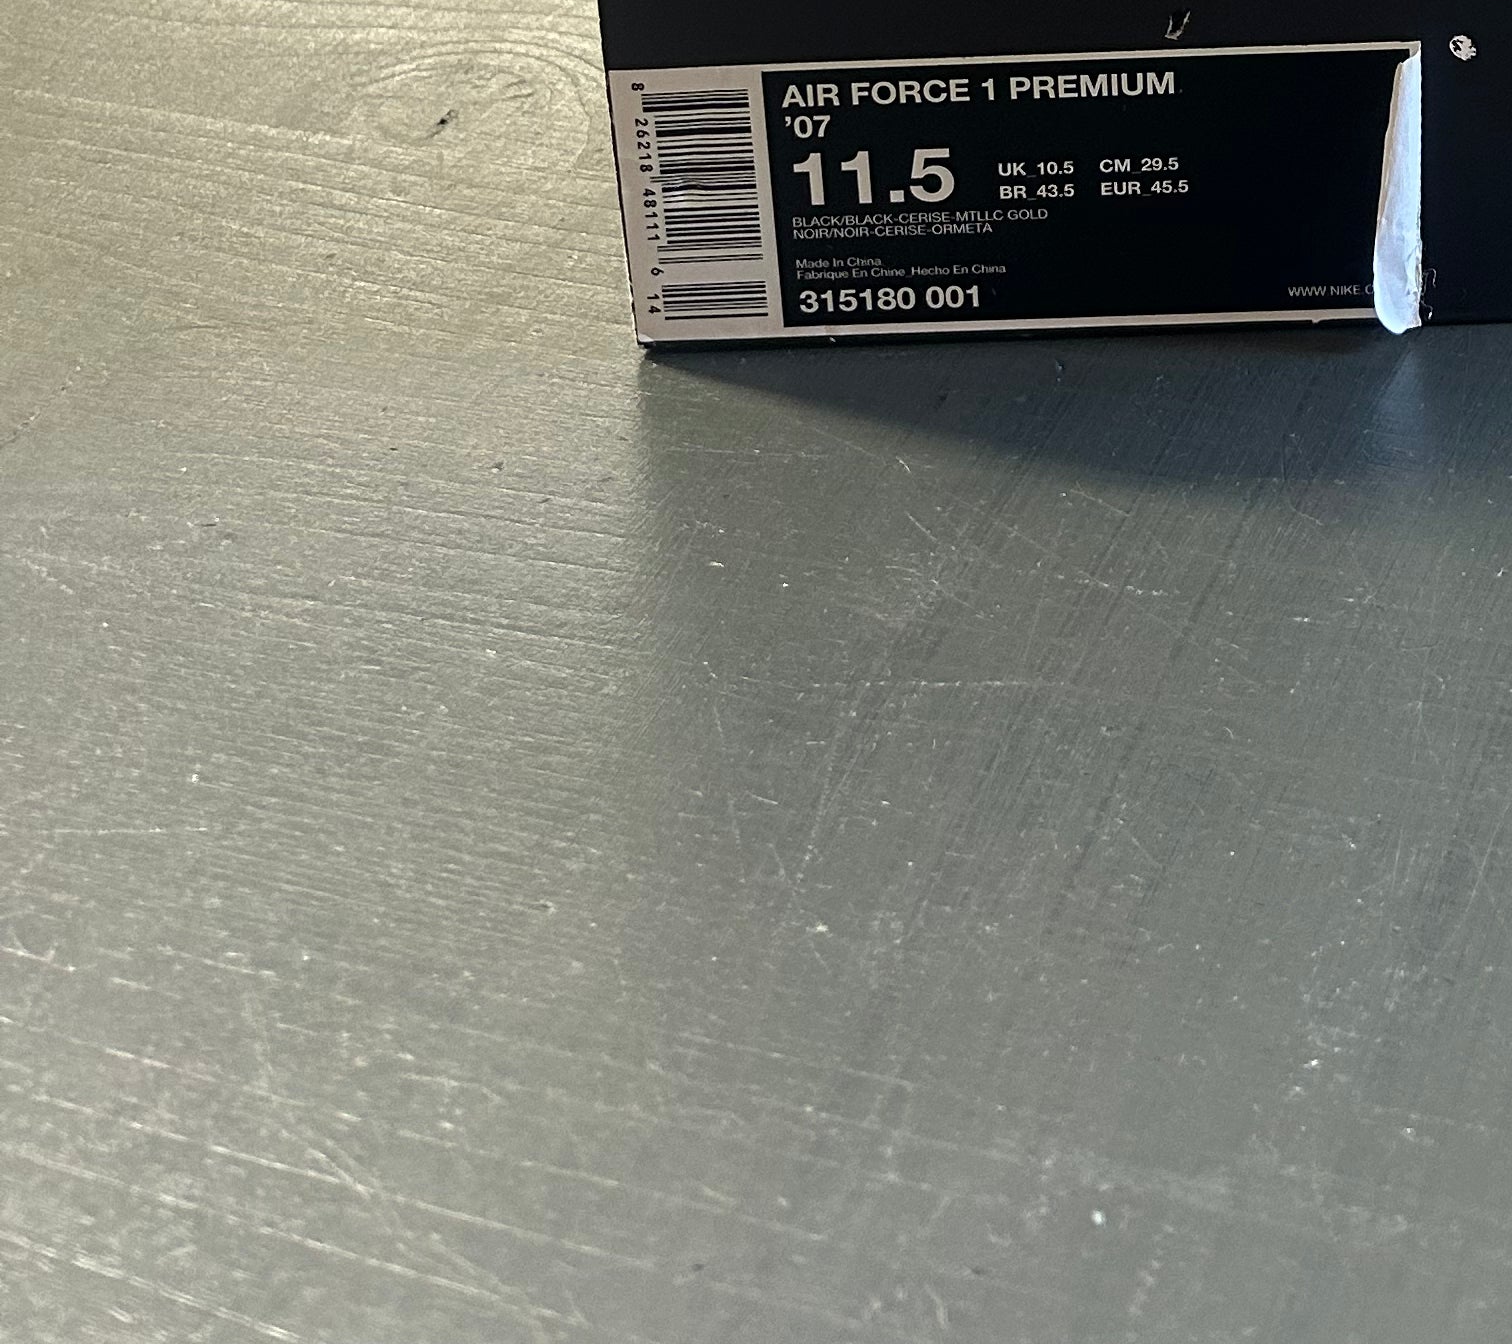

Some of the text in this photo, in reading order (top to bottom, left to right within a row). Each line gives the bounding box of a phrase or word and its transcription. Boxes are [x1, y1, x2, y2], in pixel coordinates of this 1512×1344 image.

[782, 72, 1174, 107] AIR FORCE 1 PREMIUM
[785, 115, 830, 138] '07
[794, 148, 954, 205] 11.5
[631, 82, 664, 315] 8 26218 48111 6 14
[1008, 209, 1047, 220] GOLD
[796, 256, 881, 269] Made In China
[797, 269, 848, 281] Fabrique
[852, 268, 867, 278] En
[953, 265, 968, 274] En
[972, 263, 1006, 273] China
[800, 285, 979, 312] 315180 001
